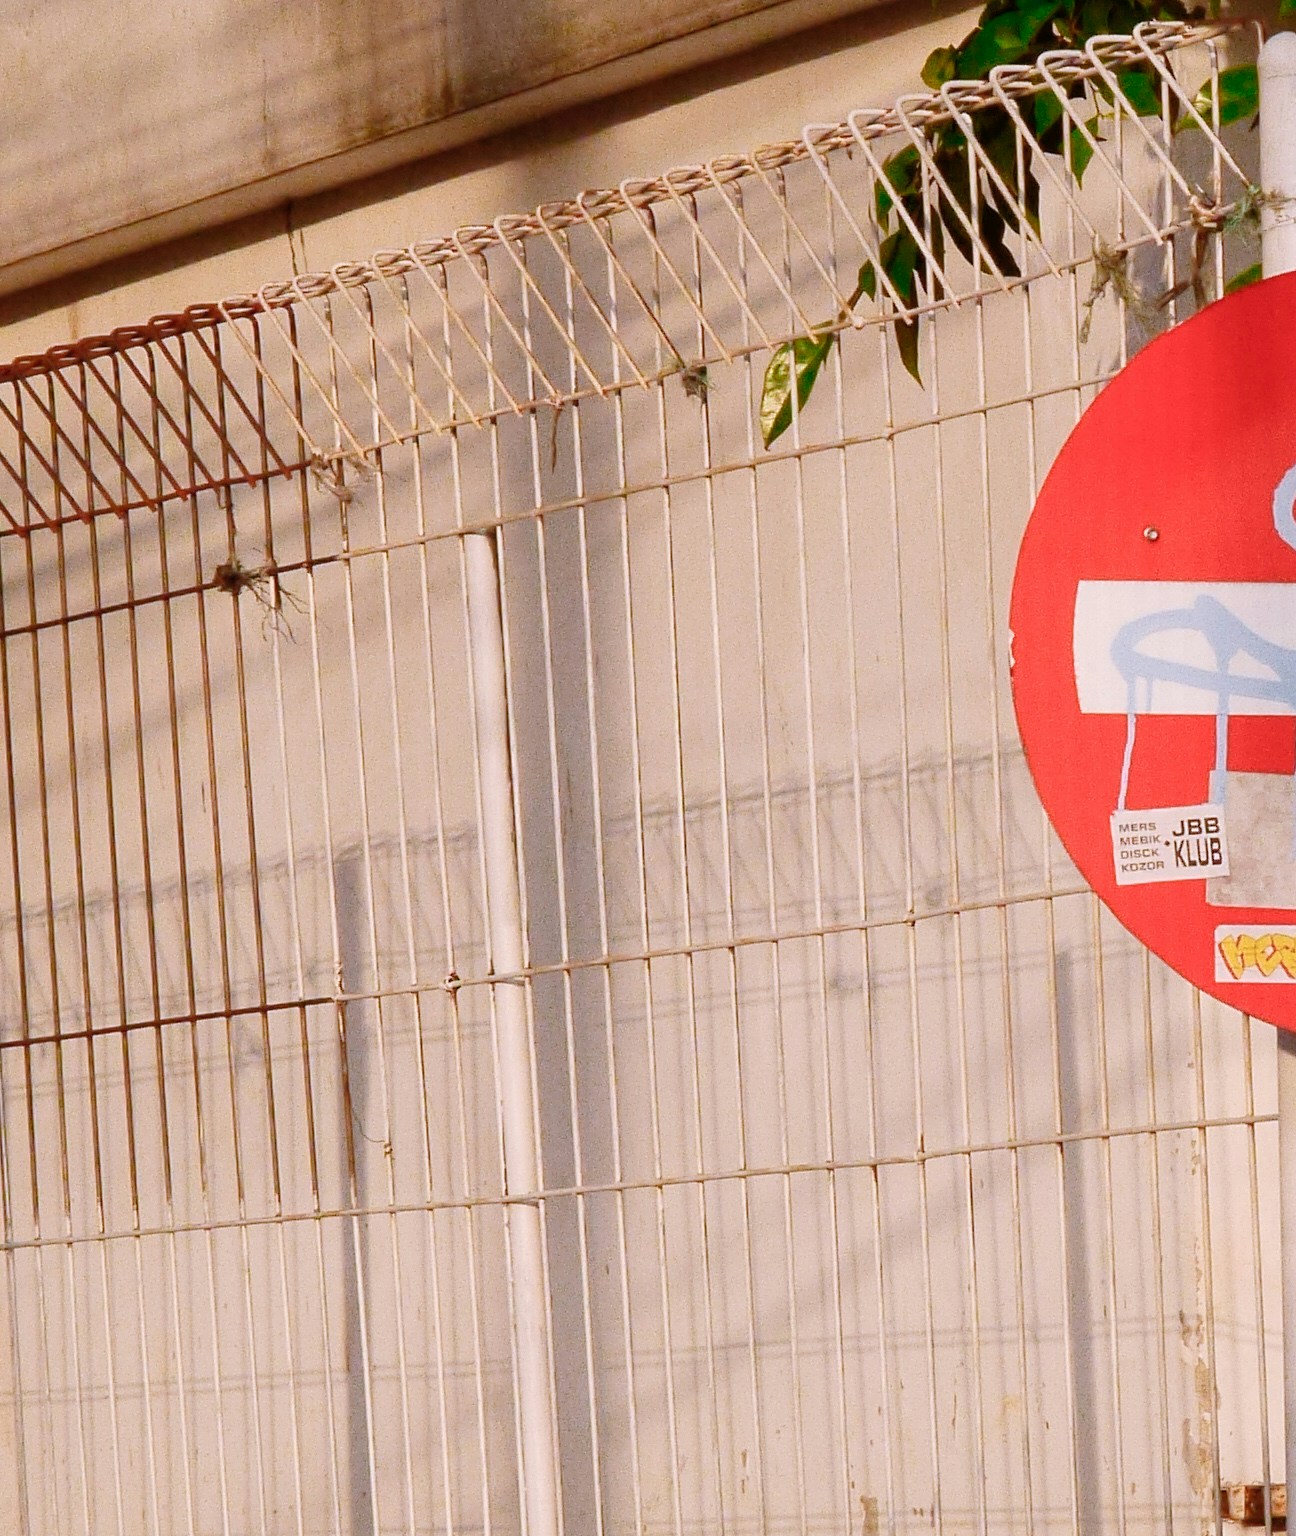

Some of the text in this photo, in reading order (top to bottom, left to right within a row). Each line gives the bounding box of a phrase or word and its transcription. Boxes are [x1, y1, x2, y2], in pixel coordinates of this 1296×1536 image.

[1119, 822, 1157, 833] MERS
[1172, 817, 1220, 837] JBB
[1120, 848, 1159, 859] DISCK
[1174, 837, 1223, 867] KLUB
